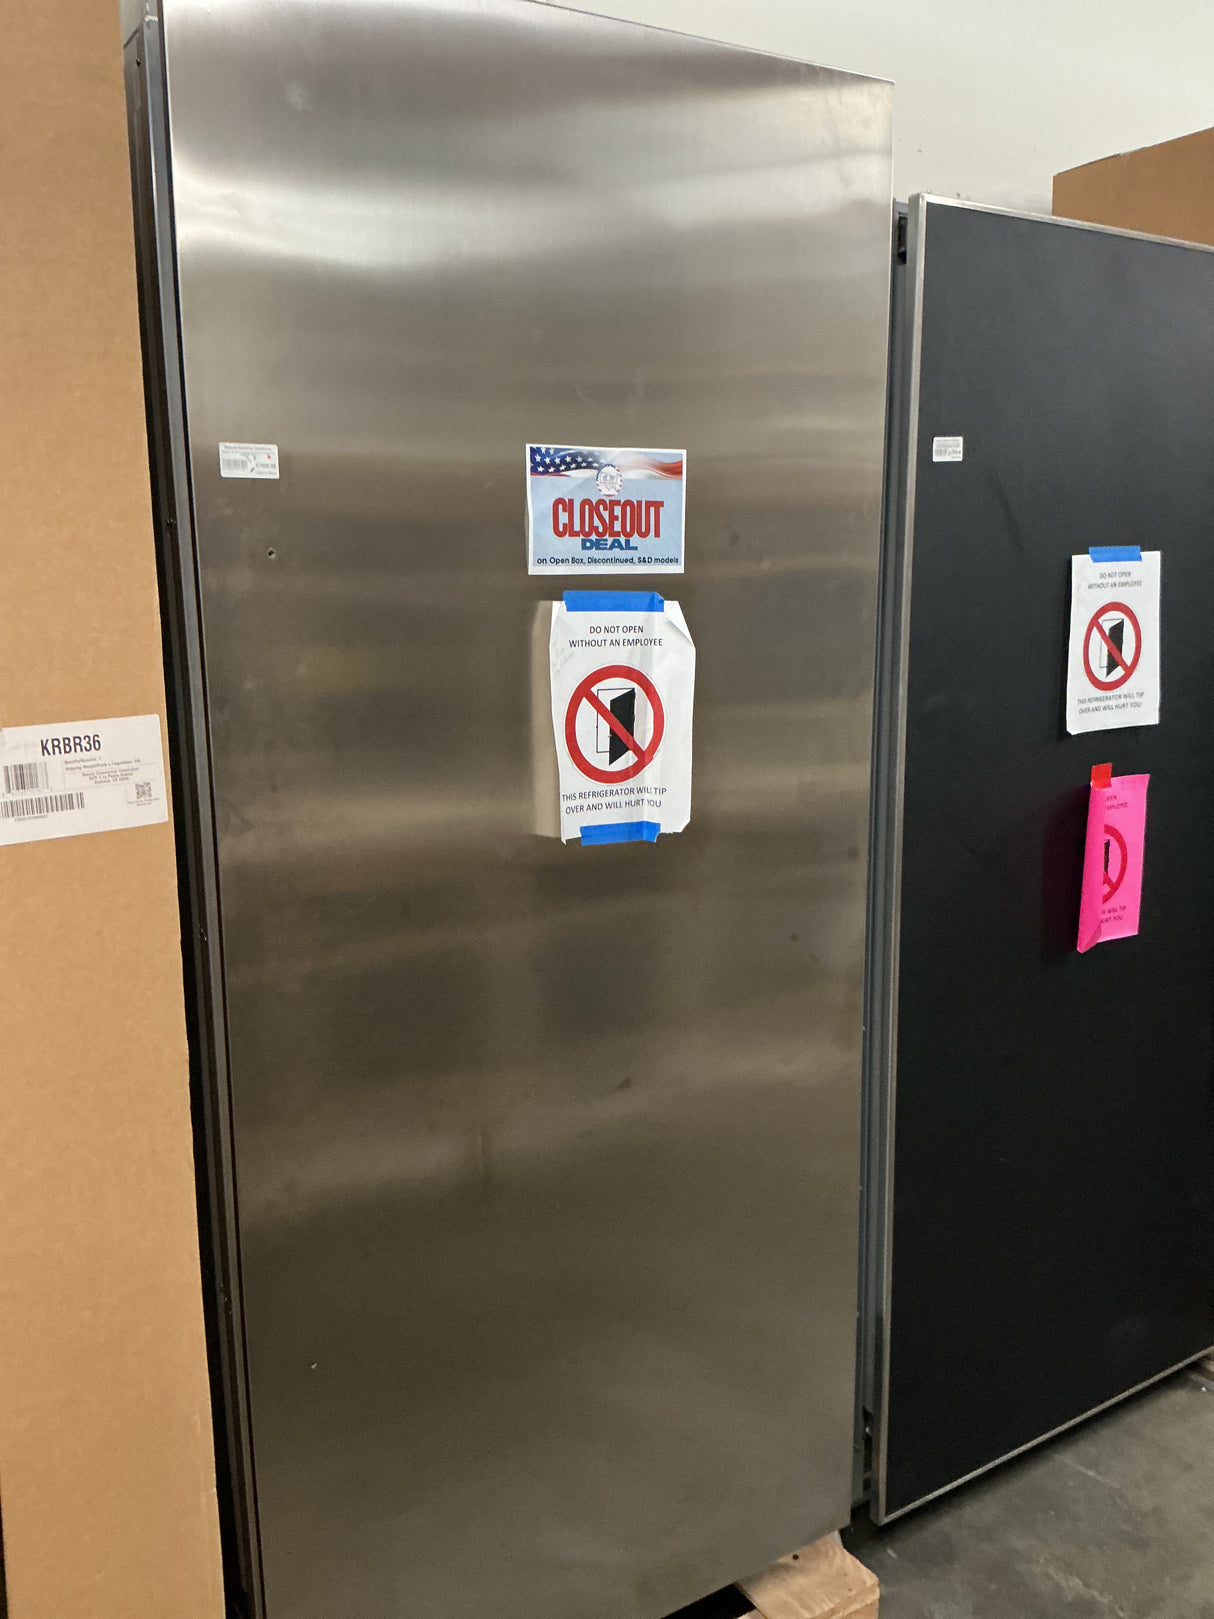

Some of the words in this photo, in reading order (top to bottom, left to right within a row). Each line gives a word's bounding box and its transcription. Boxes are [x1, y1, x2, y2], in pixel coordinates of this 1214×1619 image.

[552, 498, 664, 538] CLOSEOUT
[581, 538, 638, 550] DEAL
[549, 557, 570, 565] Open
[571, 557, 586, 565] Box,
[587, 557, 636, 565] Discontinued,
[589, 626, 602, 634] DO
[604, 626, 620, 634] NOT
[622, 625, 644, 633] OPEN
[569, 639, 607, 648] WITHOUT
[609, 639, 621, 647] AN
[622, 638, 663, 647] EMPLOYEE
[1088, 694, 1122, 704] REFRIGERATOR
[1102, 703, 1114, 711] WILL
[40, 734, 102, 757] KRBR36
[562, 793, 577, 802] THIS
[578, 787, 635, 800] REFRIGERATOR
[654, 787, 667, 795] TIP
[565, 806, 585, 815] OVER
[586, 803, 603, 812] AND
[605, 802, 622, 810] WILL
[624, 799, 645, 808] HURT
